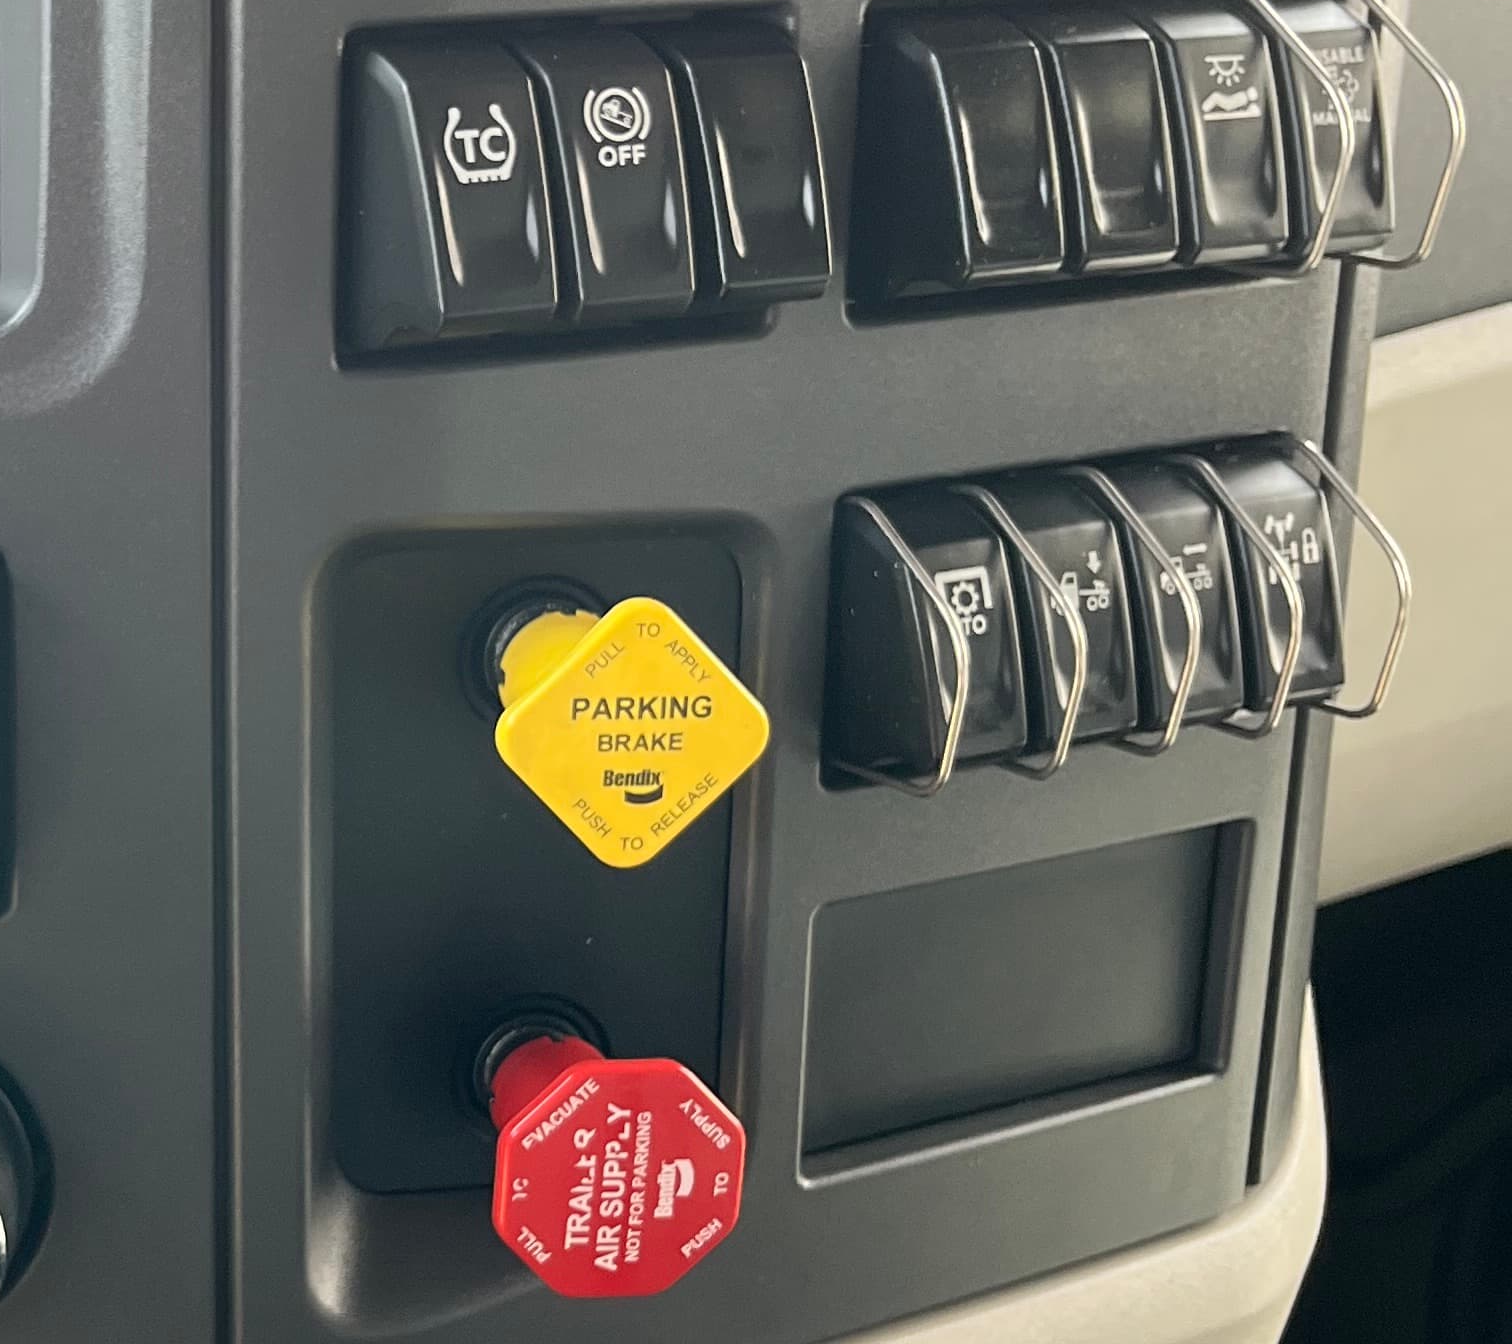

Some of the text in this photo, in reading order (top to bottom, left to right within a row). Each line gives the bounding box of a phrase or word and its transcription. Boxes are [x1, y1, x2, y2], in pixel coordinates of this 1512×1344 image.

[1312, 108, 1371, 125] MAAL
[453, 126, 507, 163] TC
[597, 144, 647, 167] OFF
[584, 622, 712, 684] PULL TO APPLY
[571, 695, 712, 721] PARKING
[597, 732, 683, 752] BRAKE
[602, 769, 662, 787] Bendix
[572, 772, 719, 851] PUSH TO RELEASE
[520, 1077, 600, 1151] EVACUATE
[594, 1102, 632, 1272] AIR SUPPLY
[624, 1111, 652, 1262] NOT FOR PARKING
[678, 1099, 731, 1259] PUSH TO SUPPLY
[516, 1226, 553, 1265] PULL
